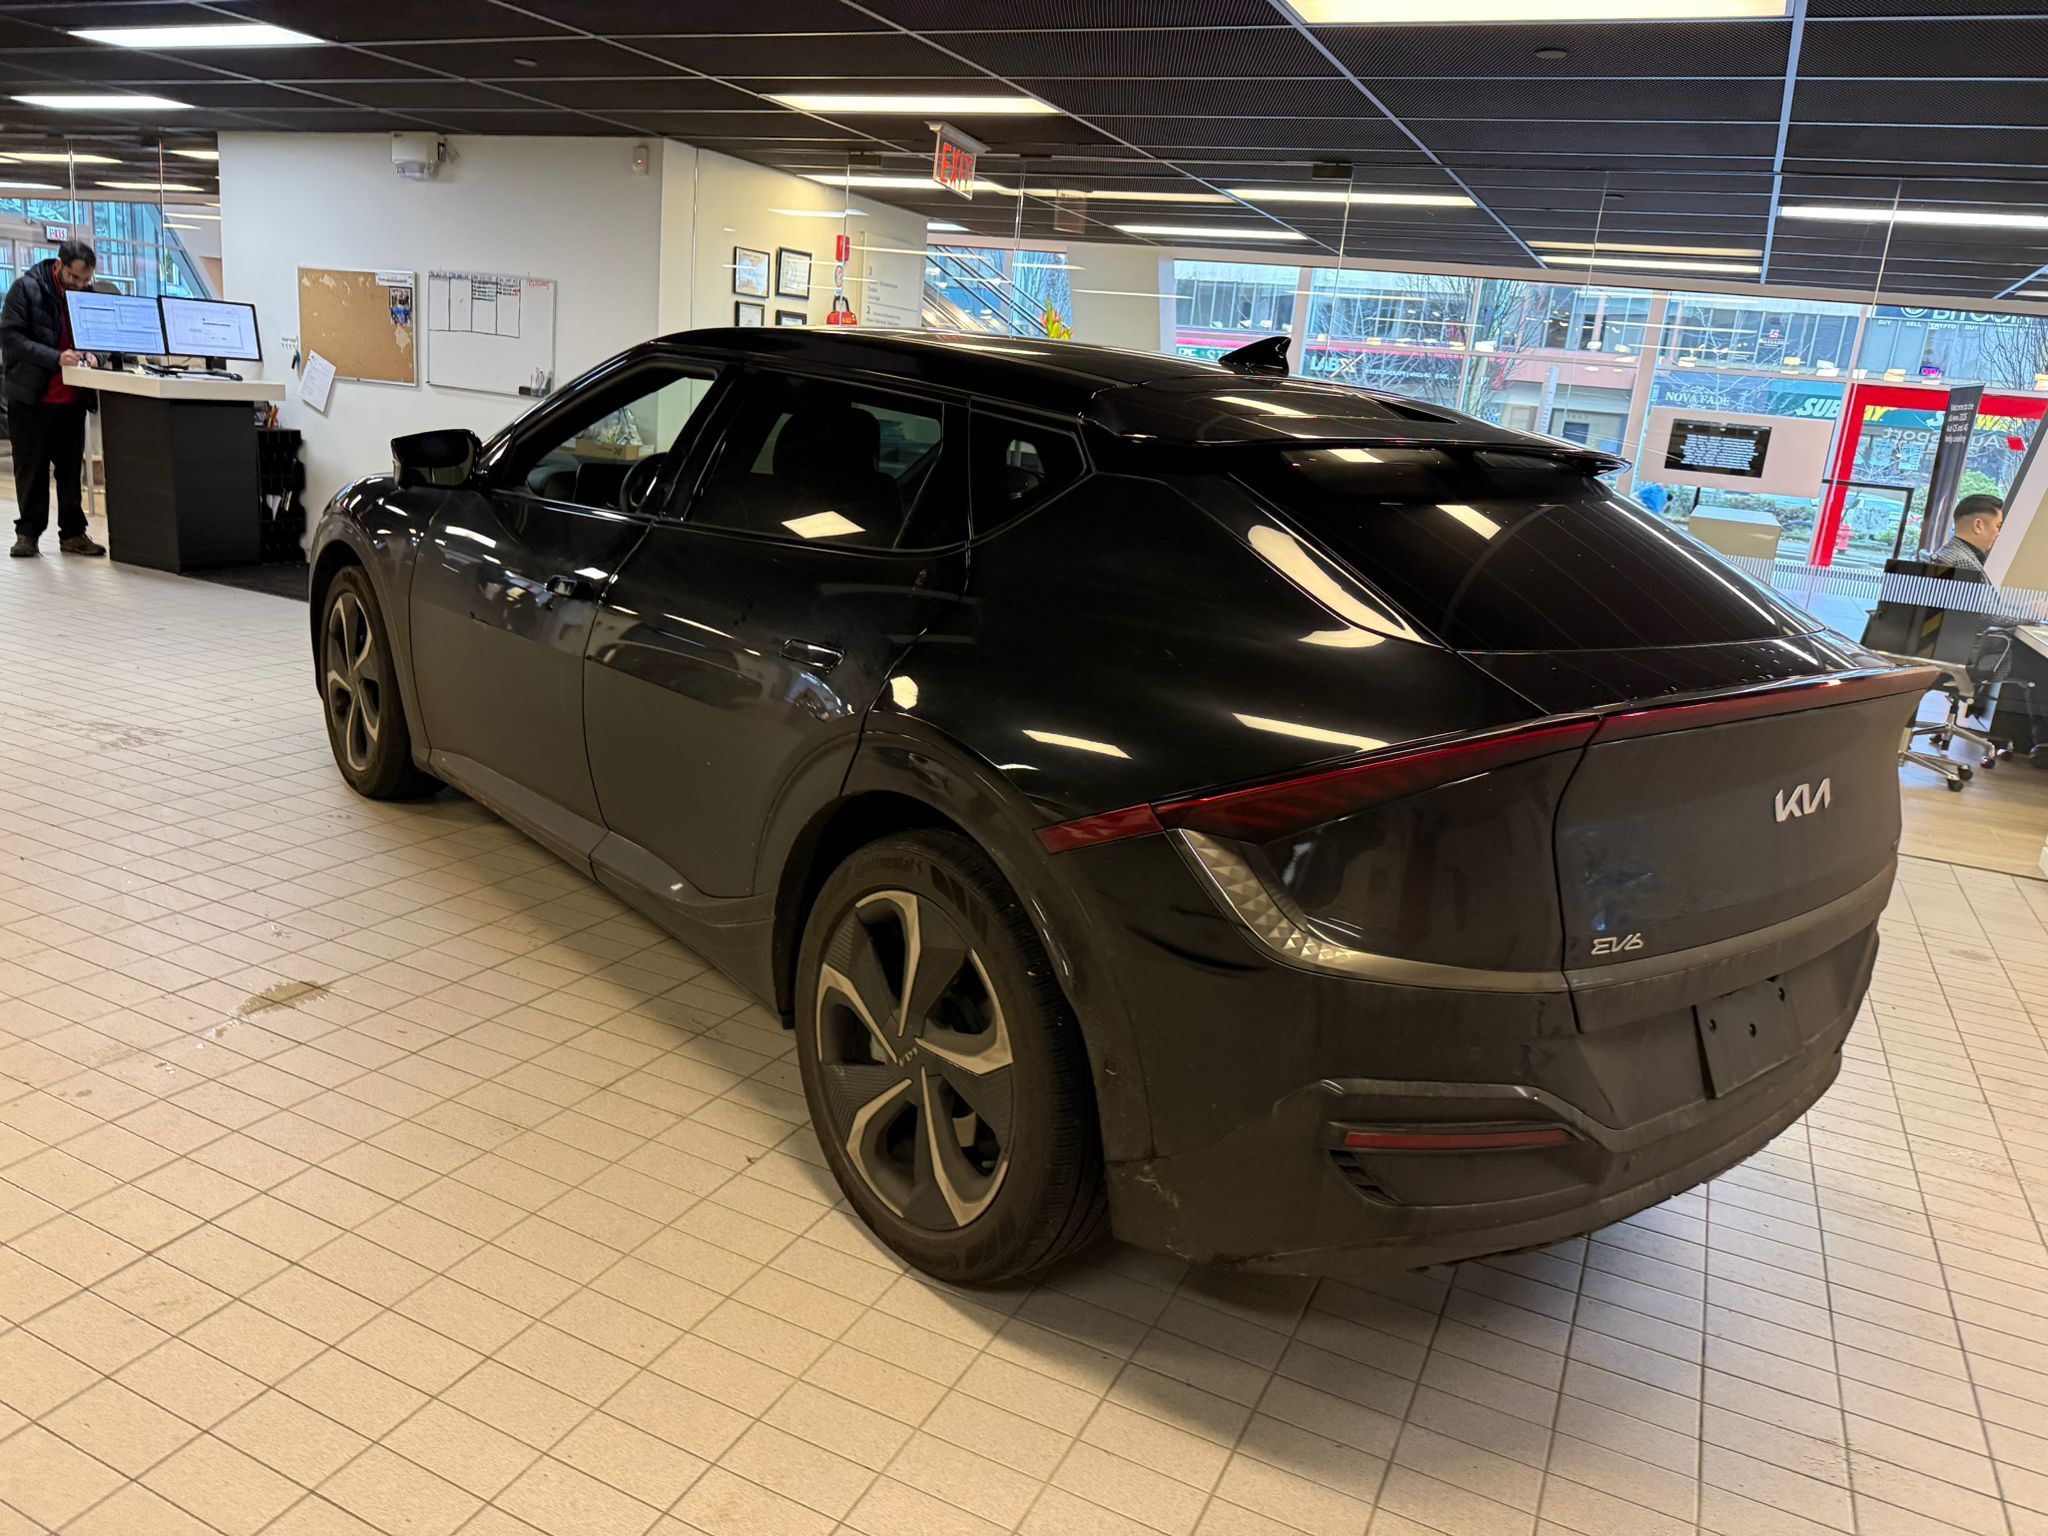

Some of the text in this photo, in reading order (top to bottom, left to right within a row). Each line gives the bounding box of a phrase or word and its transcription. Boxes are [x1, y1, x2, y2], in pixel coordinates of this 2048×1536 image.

[941, 142, 973, 191] EXIT
[1665, 391, 1701, 404] NOVA
[1701, 396, 1730, 406] FADE
[1774, 777, 1831, 823] KIA
[1590, 932, 1644, 956] EV6
